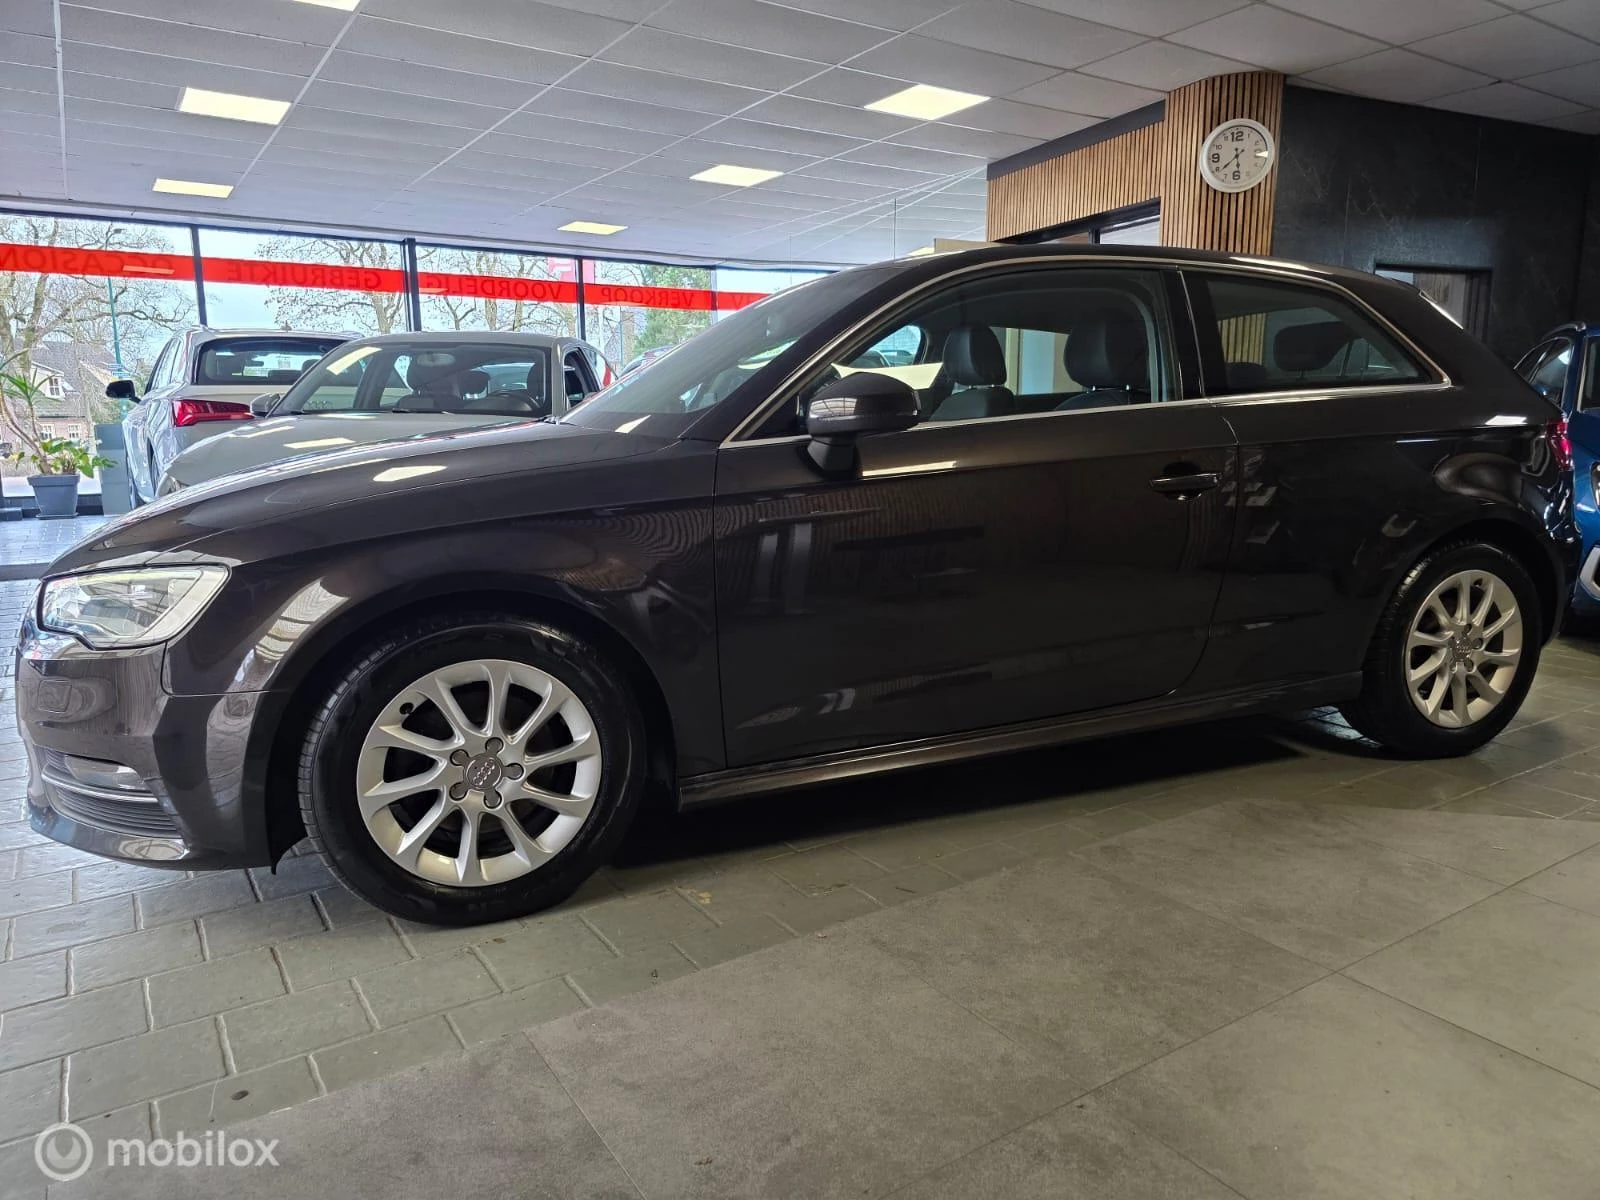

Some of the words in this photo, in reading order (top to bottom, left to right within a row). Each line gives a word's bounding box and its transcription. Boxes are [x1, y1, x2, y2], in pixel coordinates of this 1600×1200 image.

[1230, 131, 1244, 142] 12
[1211, 153, 1220, 163] 9
[1232, 170, 1241, 181] 6
